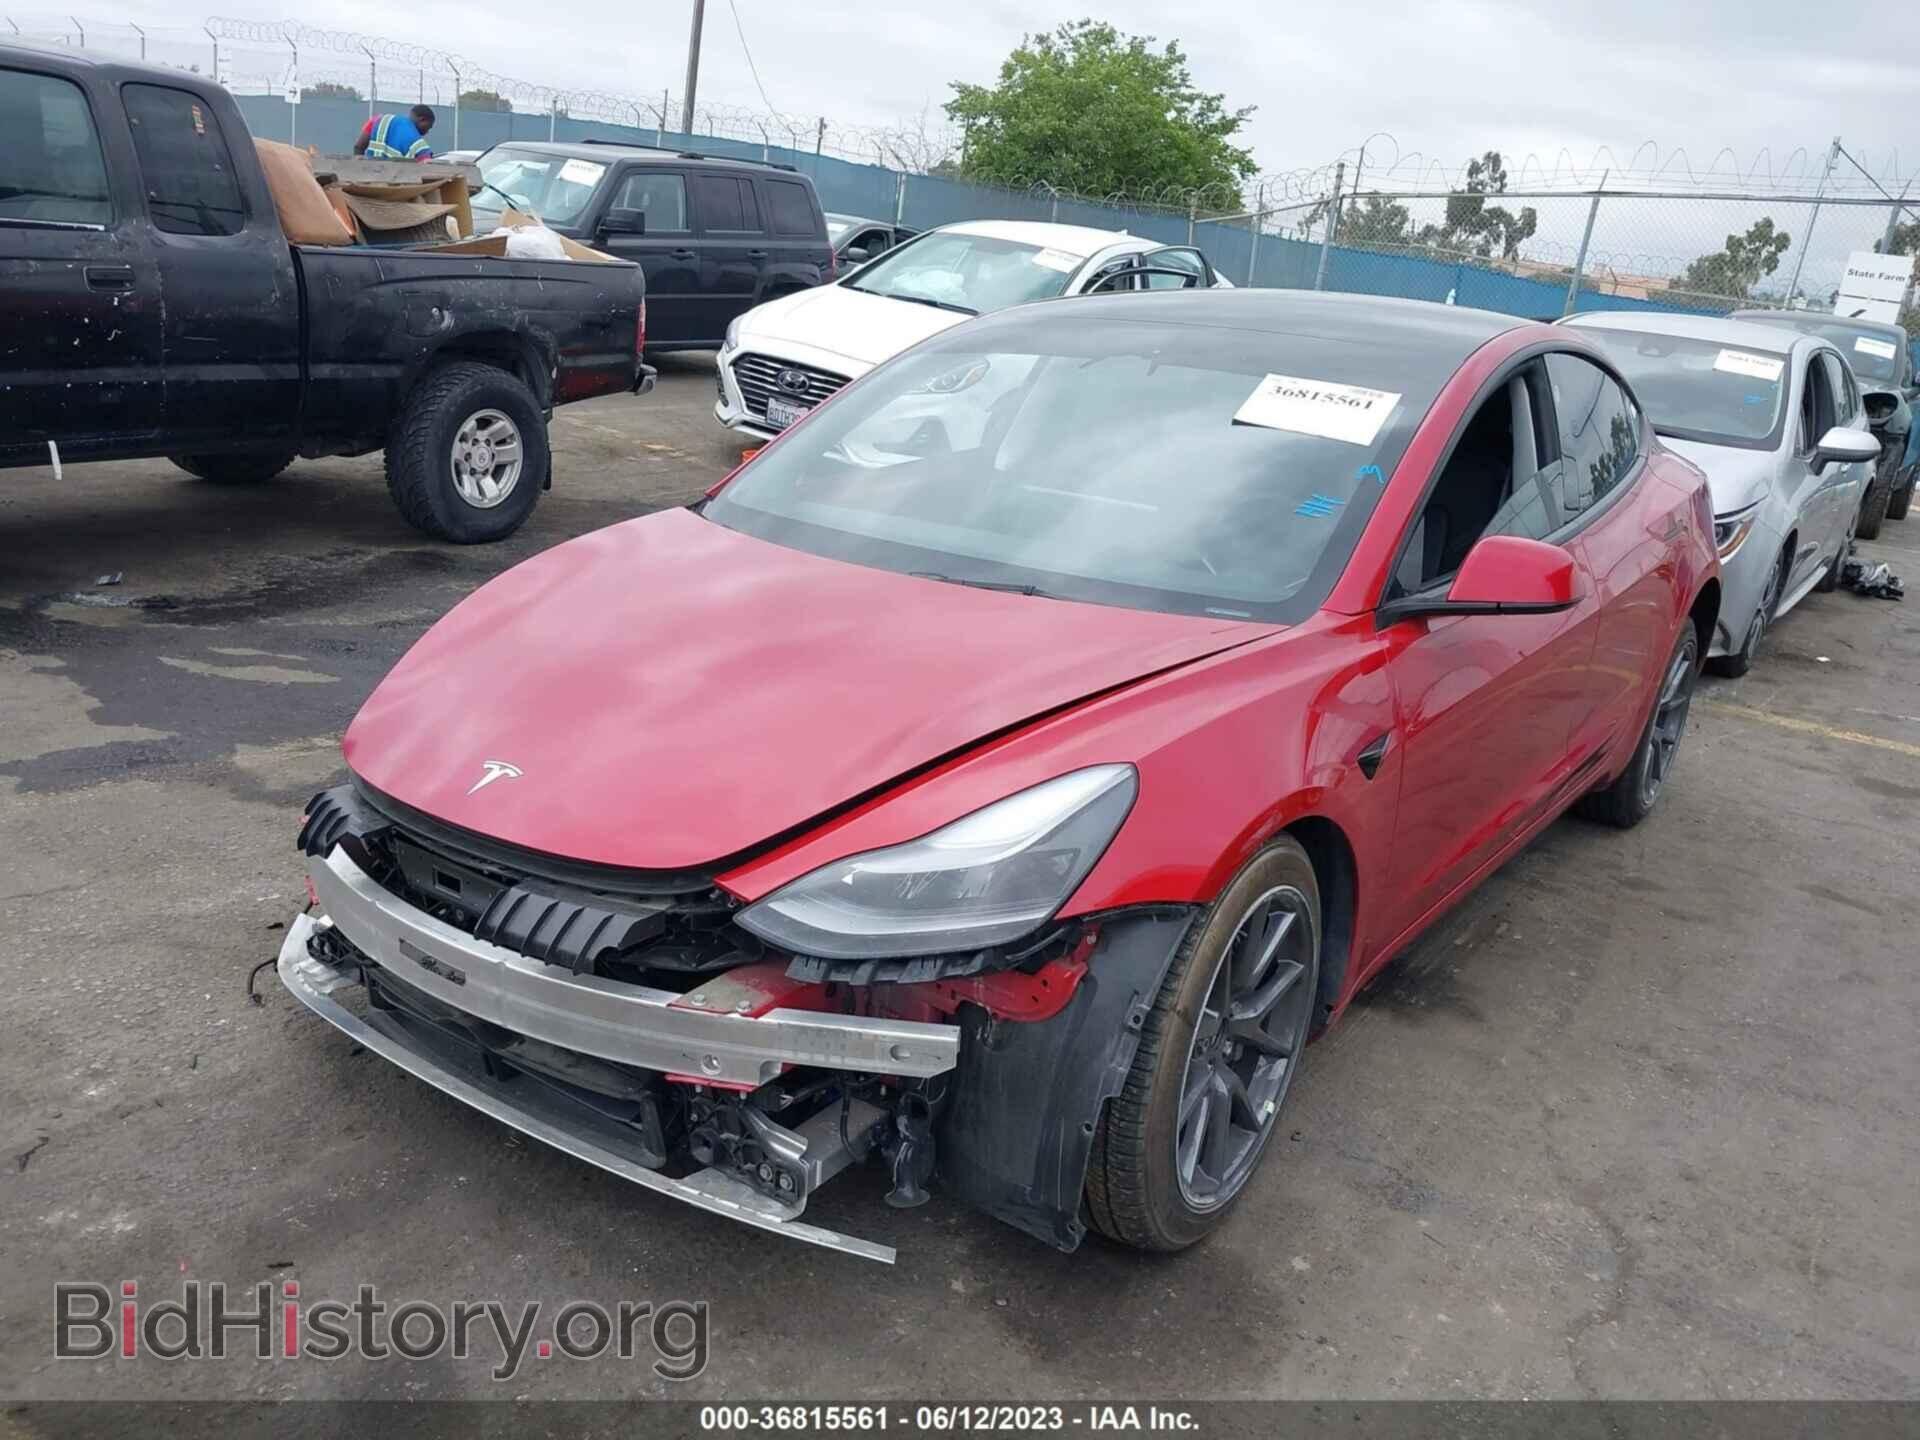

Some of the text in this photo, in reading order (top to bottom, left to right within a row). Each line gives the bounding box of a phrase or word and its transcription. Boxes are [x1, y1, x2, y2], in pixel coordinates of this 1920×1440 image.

[1848, 268, 1905, 281] State Farm
[1268, 385, 1373, 410] 36815561
